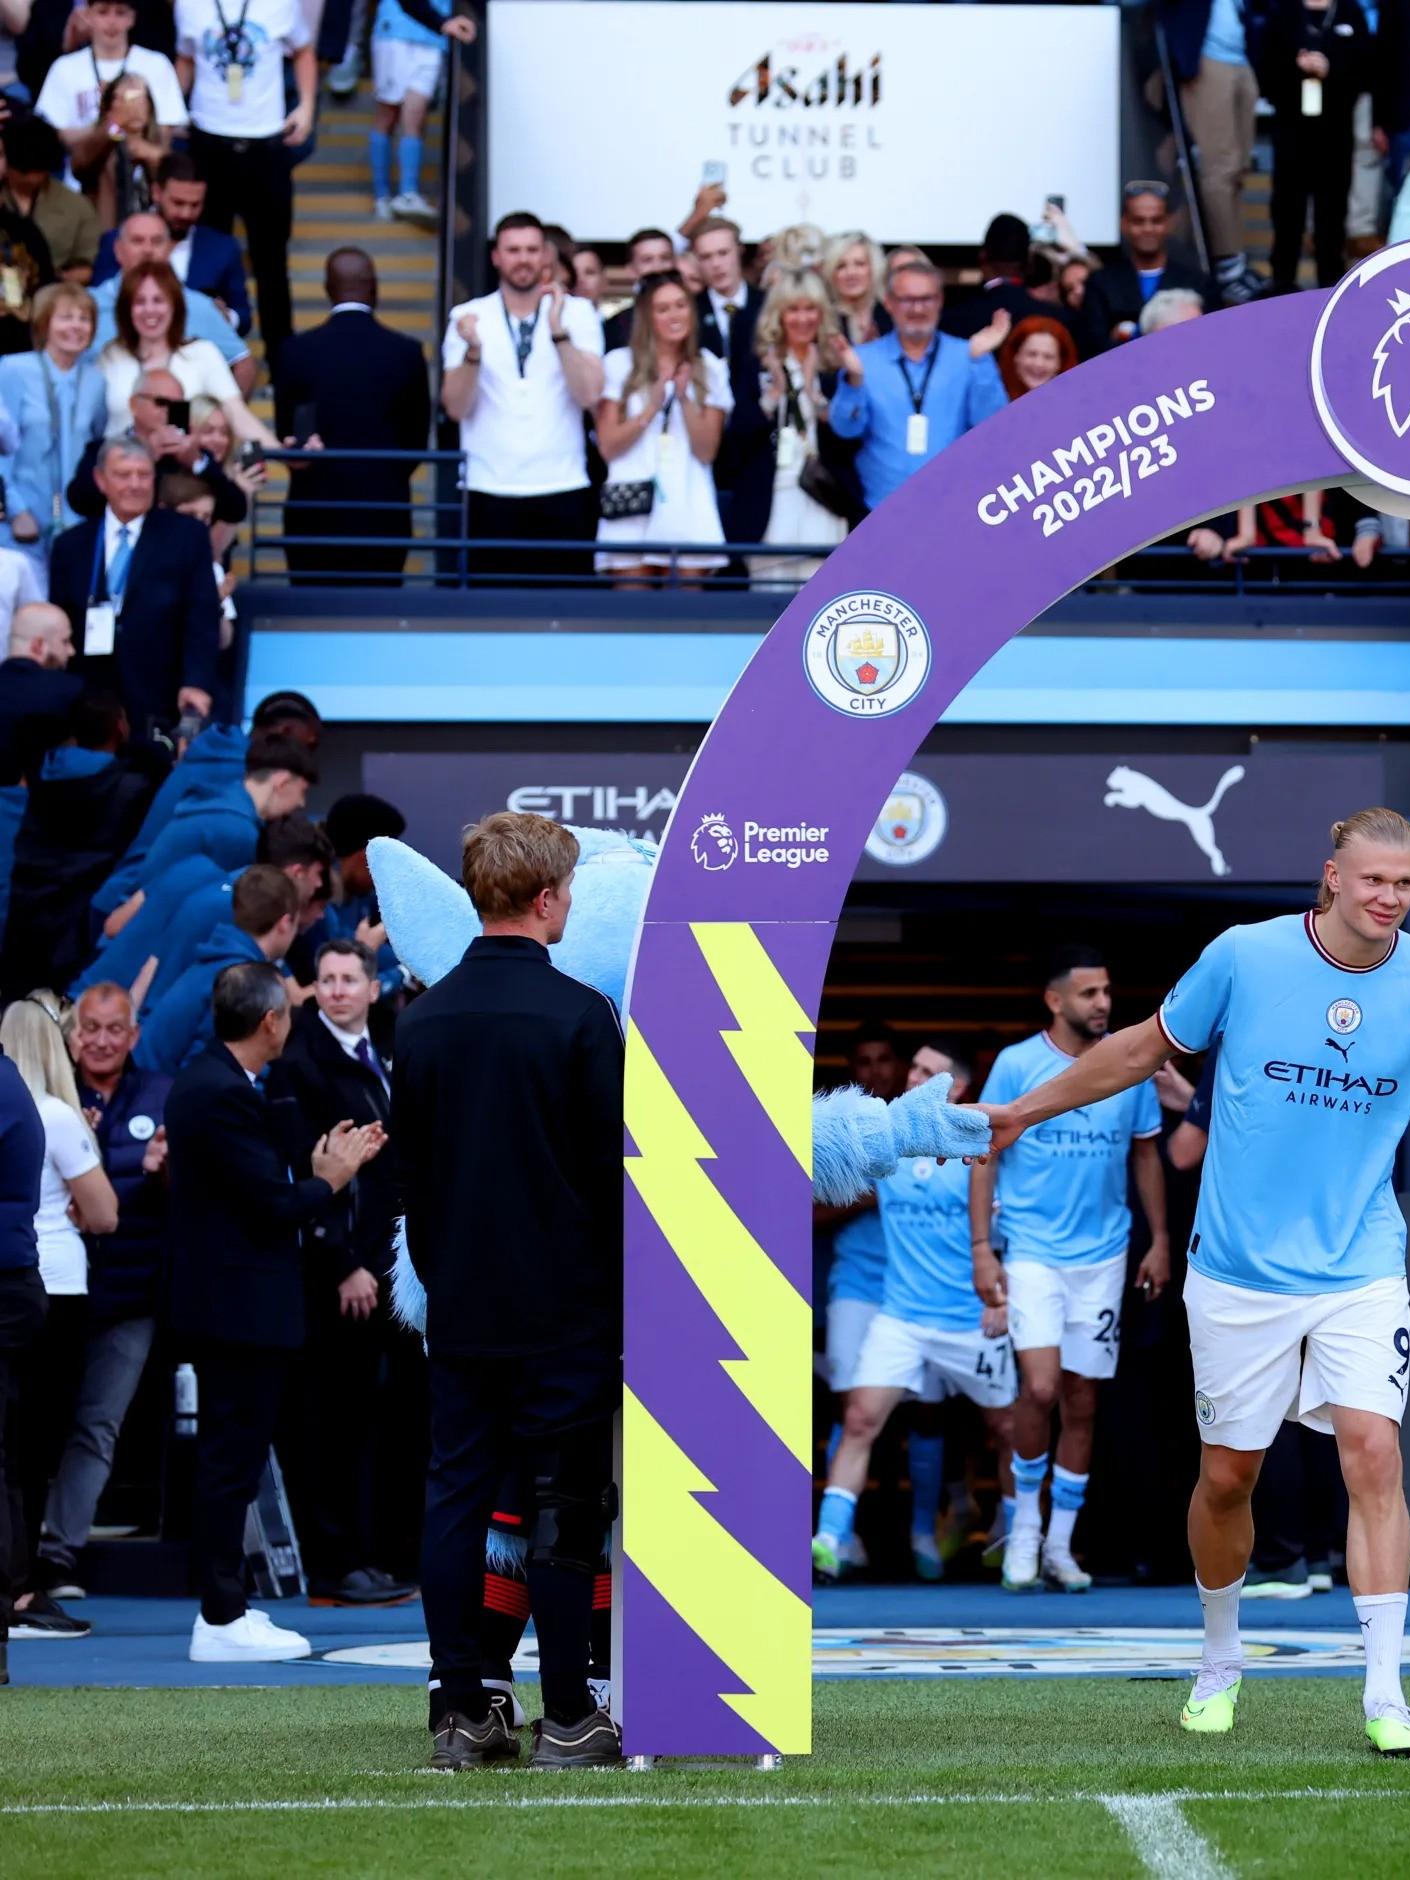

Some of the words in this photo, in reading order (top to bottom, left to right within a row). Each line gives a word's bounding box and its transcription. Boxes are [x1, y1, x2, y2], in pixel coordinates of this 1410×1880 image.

[727, 50, 883, 108] Asahi
[728, 122, 883, 149] TUNNEL
[752, 154, 857, 179] CLUB
[977, 379, 1216, 526] CHAMPIONS
[1032, 433, 1178, 537] 2022/23
[816, 598, 918, 638] MANCHESTER
[849, 698, 887, 709] CITY
[744, 822, 829, 842] Premier
[744, 843, 830, 869] League
[1263, 1060, 1398, 1096] ETIHAD
[1285, 1090, 1372, 1115] AIRWAYS
[976, 1344, 1007, 1379] 47
[1393, 1327, 1410, 1375] 9
